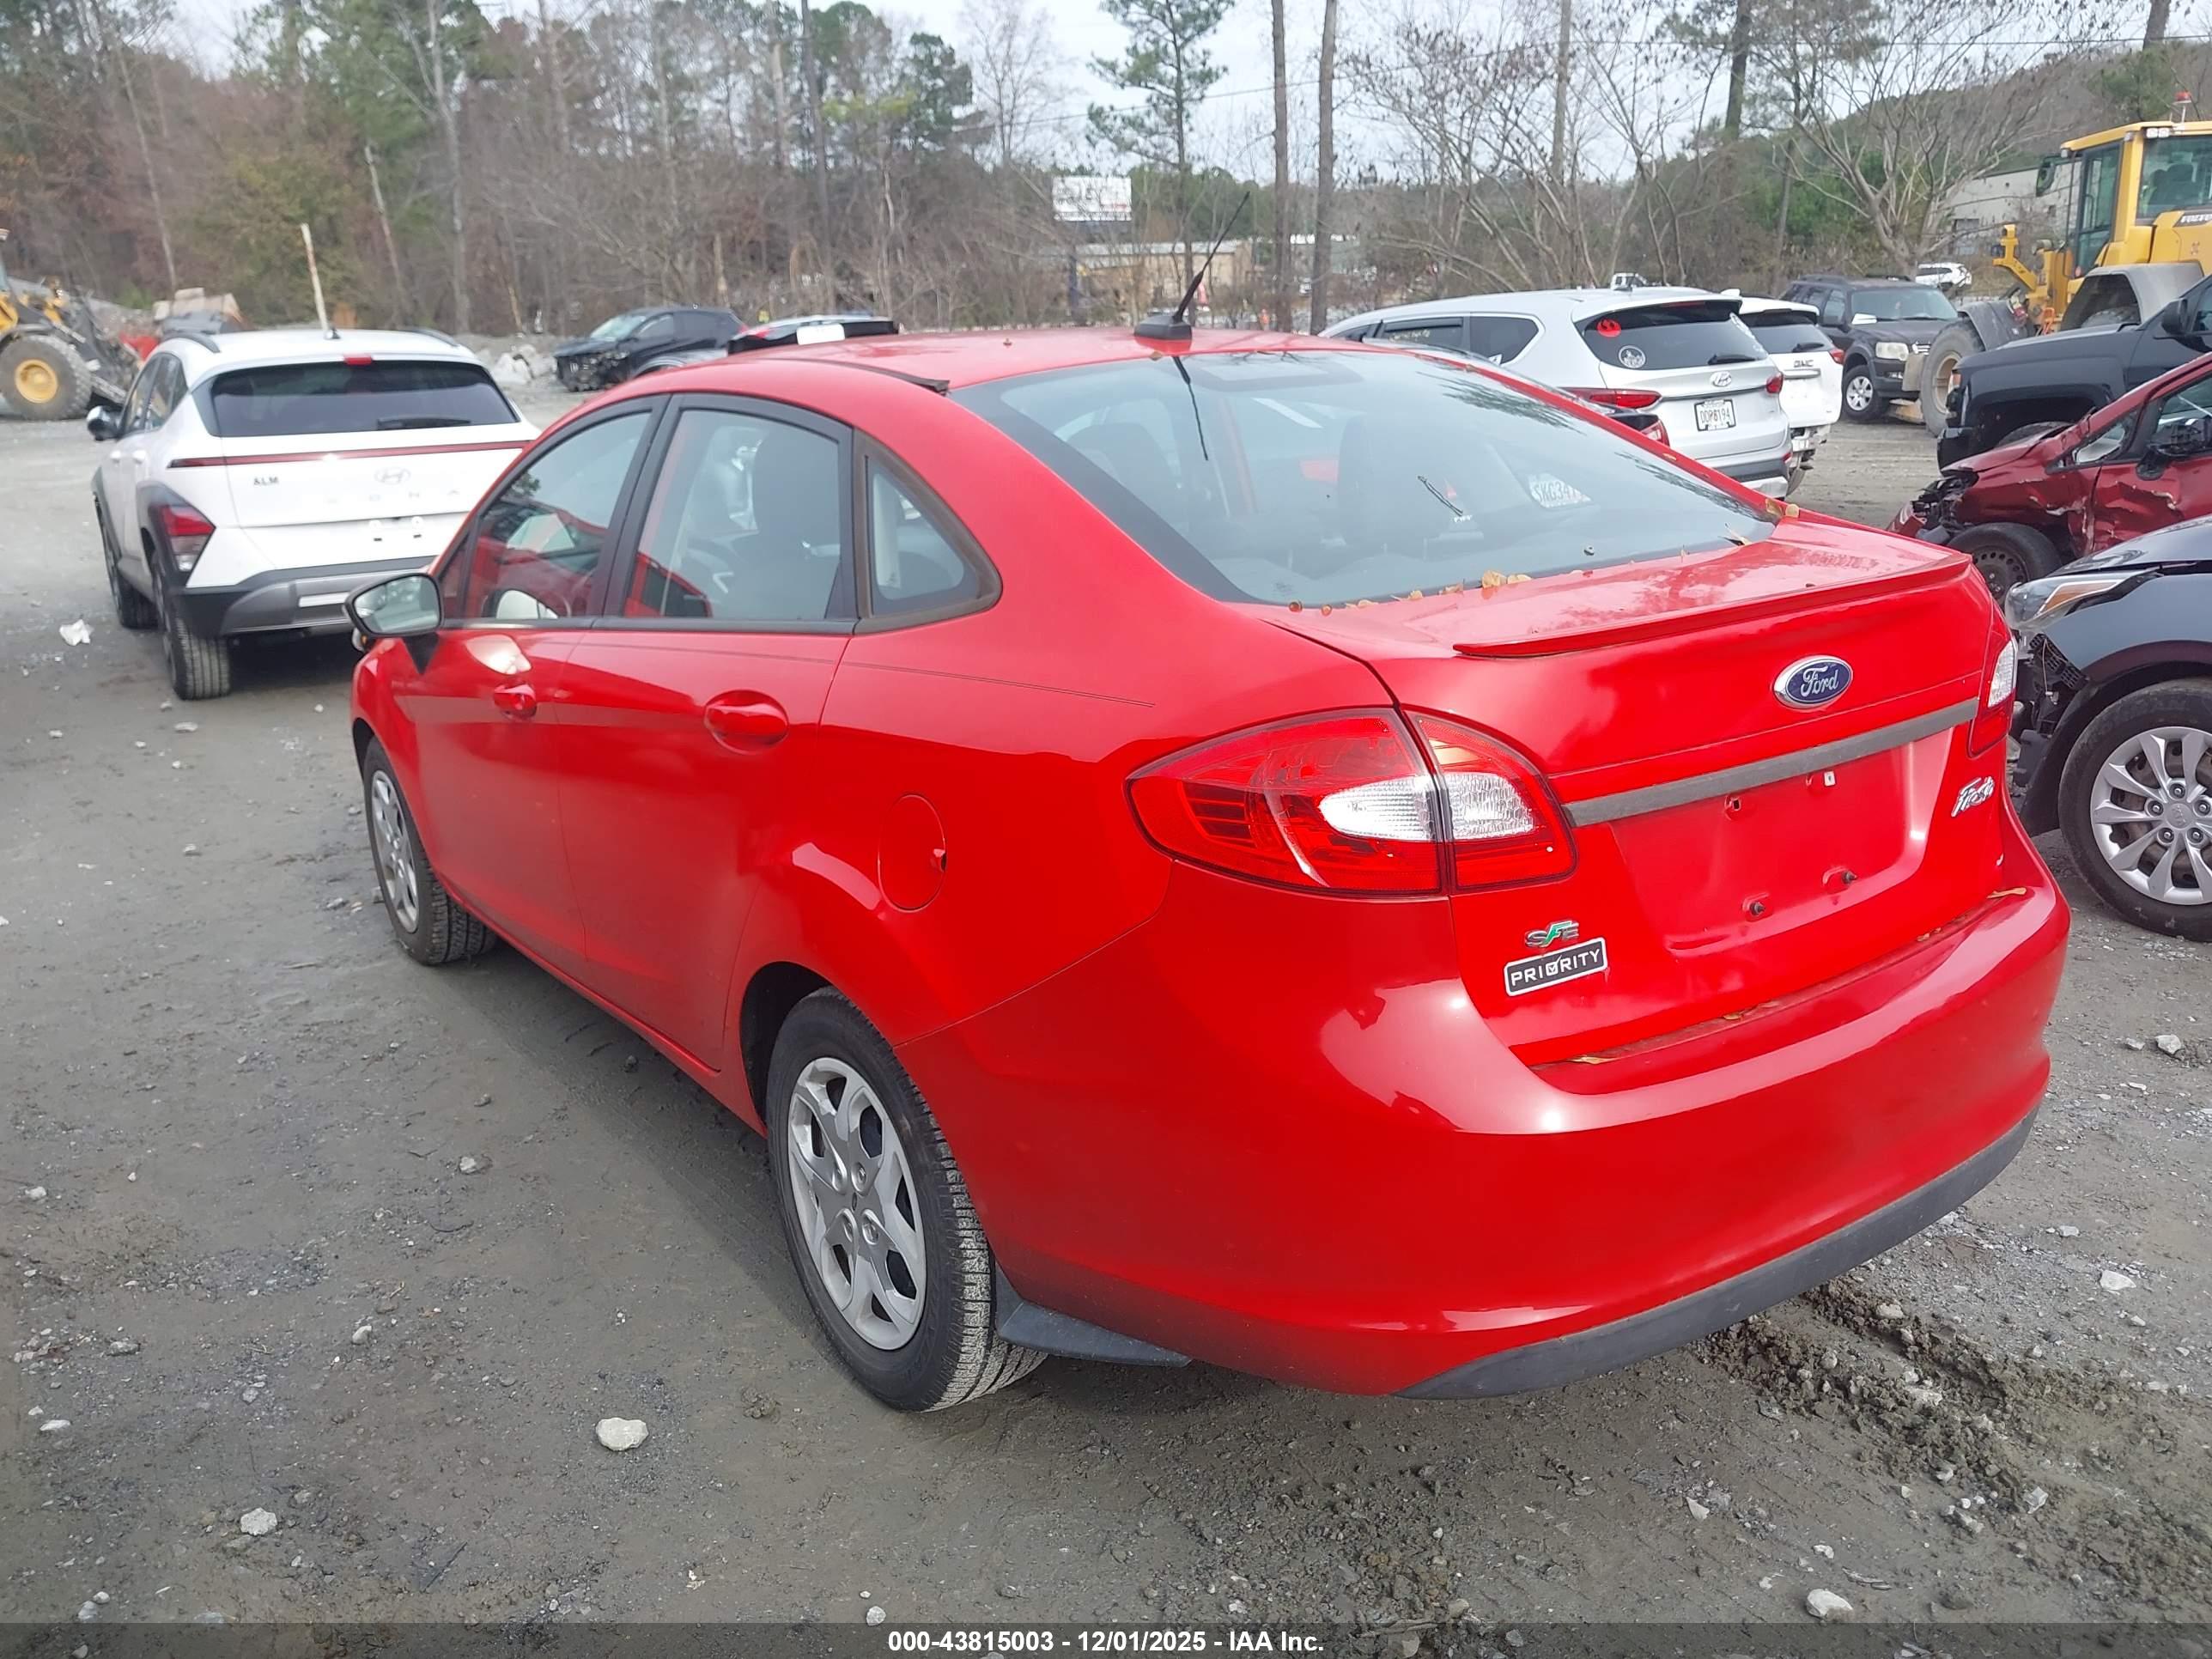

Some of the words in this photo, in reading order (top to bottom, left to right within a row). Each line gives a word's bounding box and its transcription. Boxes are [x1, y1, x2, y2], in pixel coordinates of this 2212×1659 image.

[1800, 665, 1839, 697] Ford
[1524, 919, 1579, 948] SFE
[1510, 948, 1600, 987] PRIORITY
